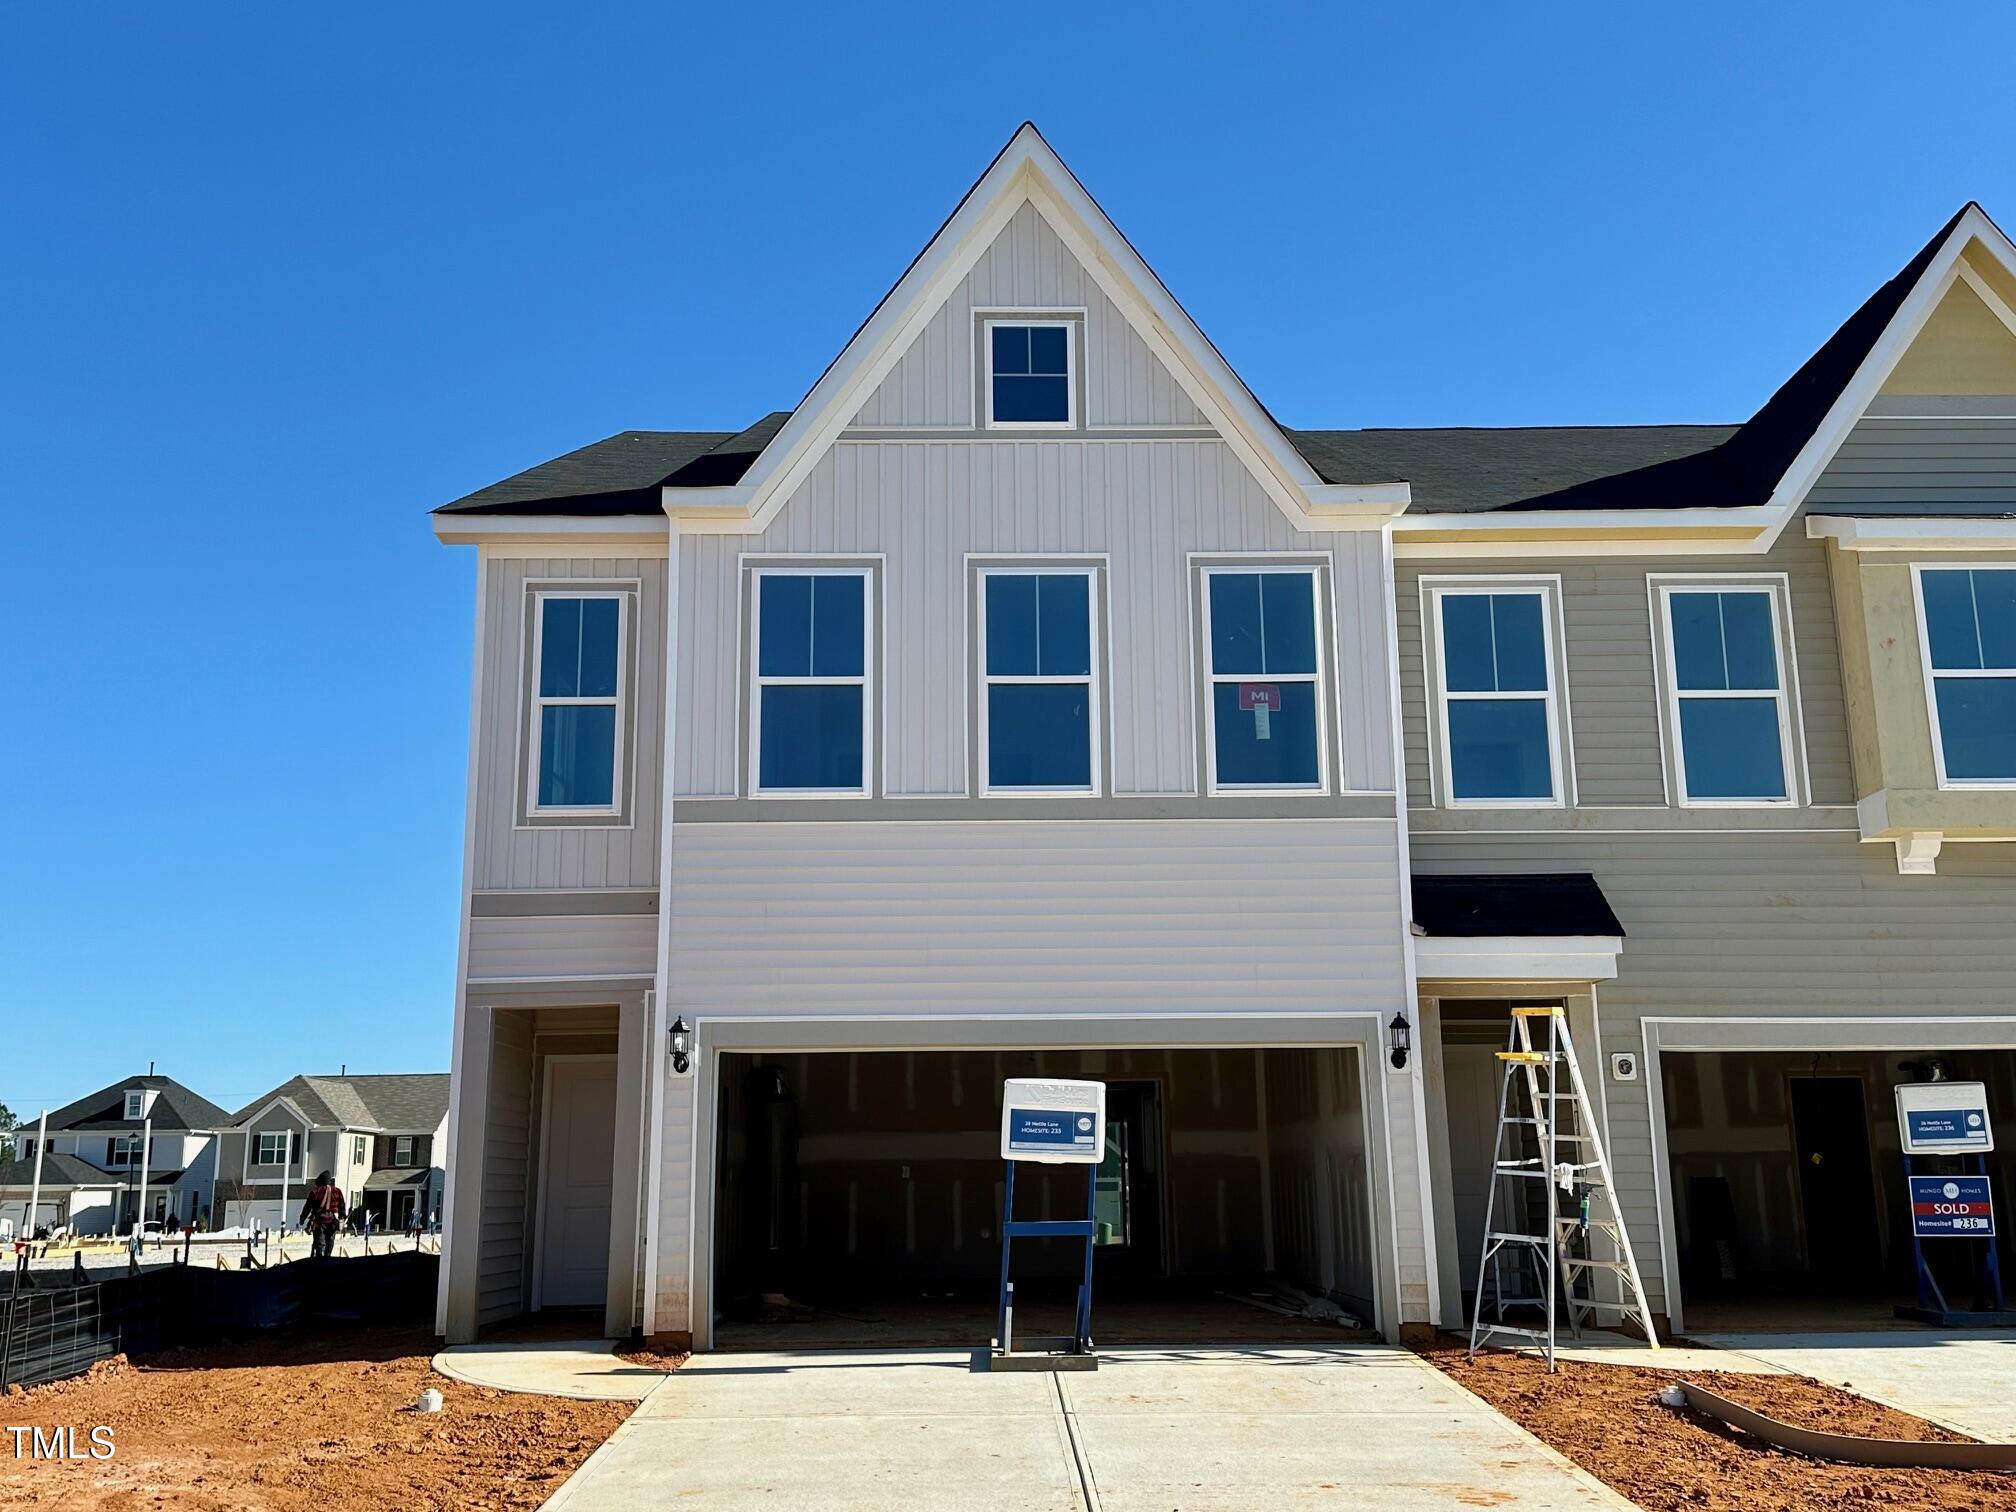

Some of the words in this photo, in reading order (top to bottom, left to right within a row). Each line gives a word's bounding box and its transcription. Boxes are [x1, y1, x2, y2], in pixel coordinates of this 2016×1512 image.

[1251, 691, 1269, 701] MI
[1933, 1203, 1970, 1215] SOLD
[1960, 1218, 1978, 1229] 236
